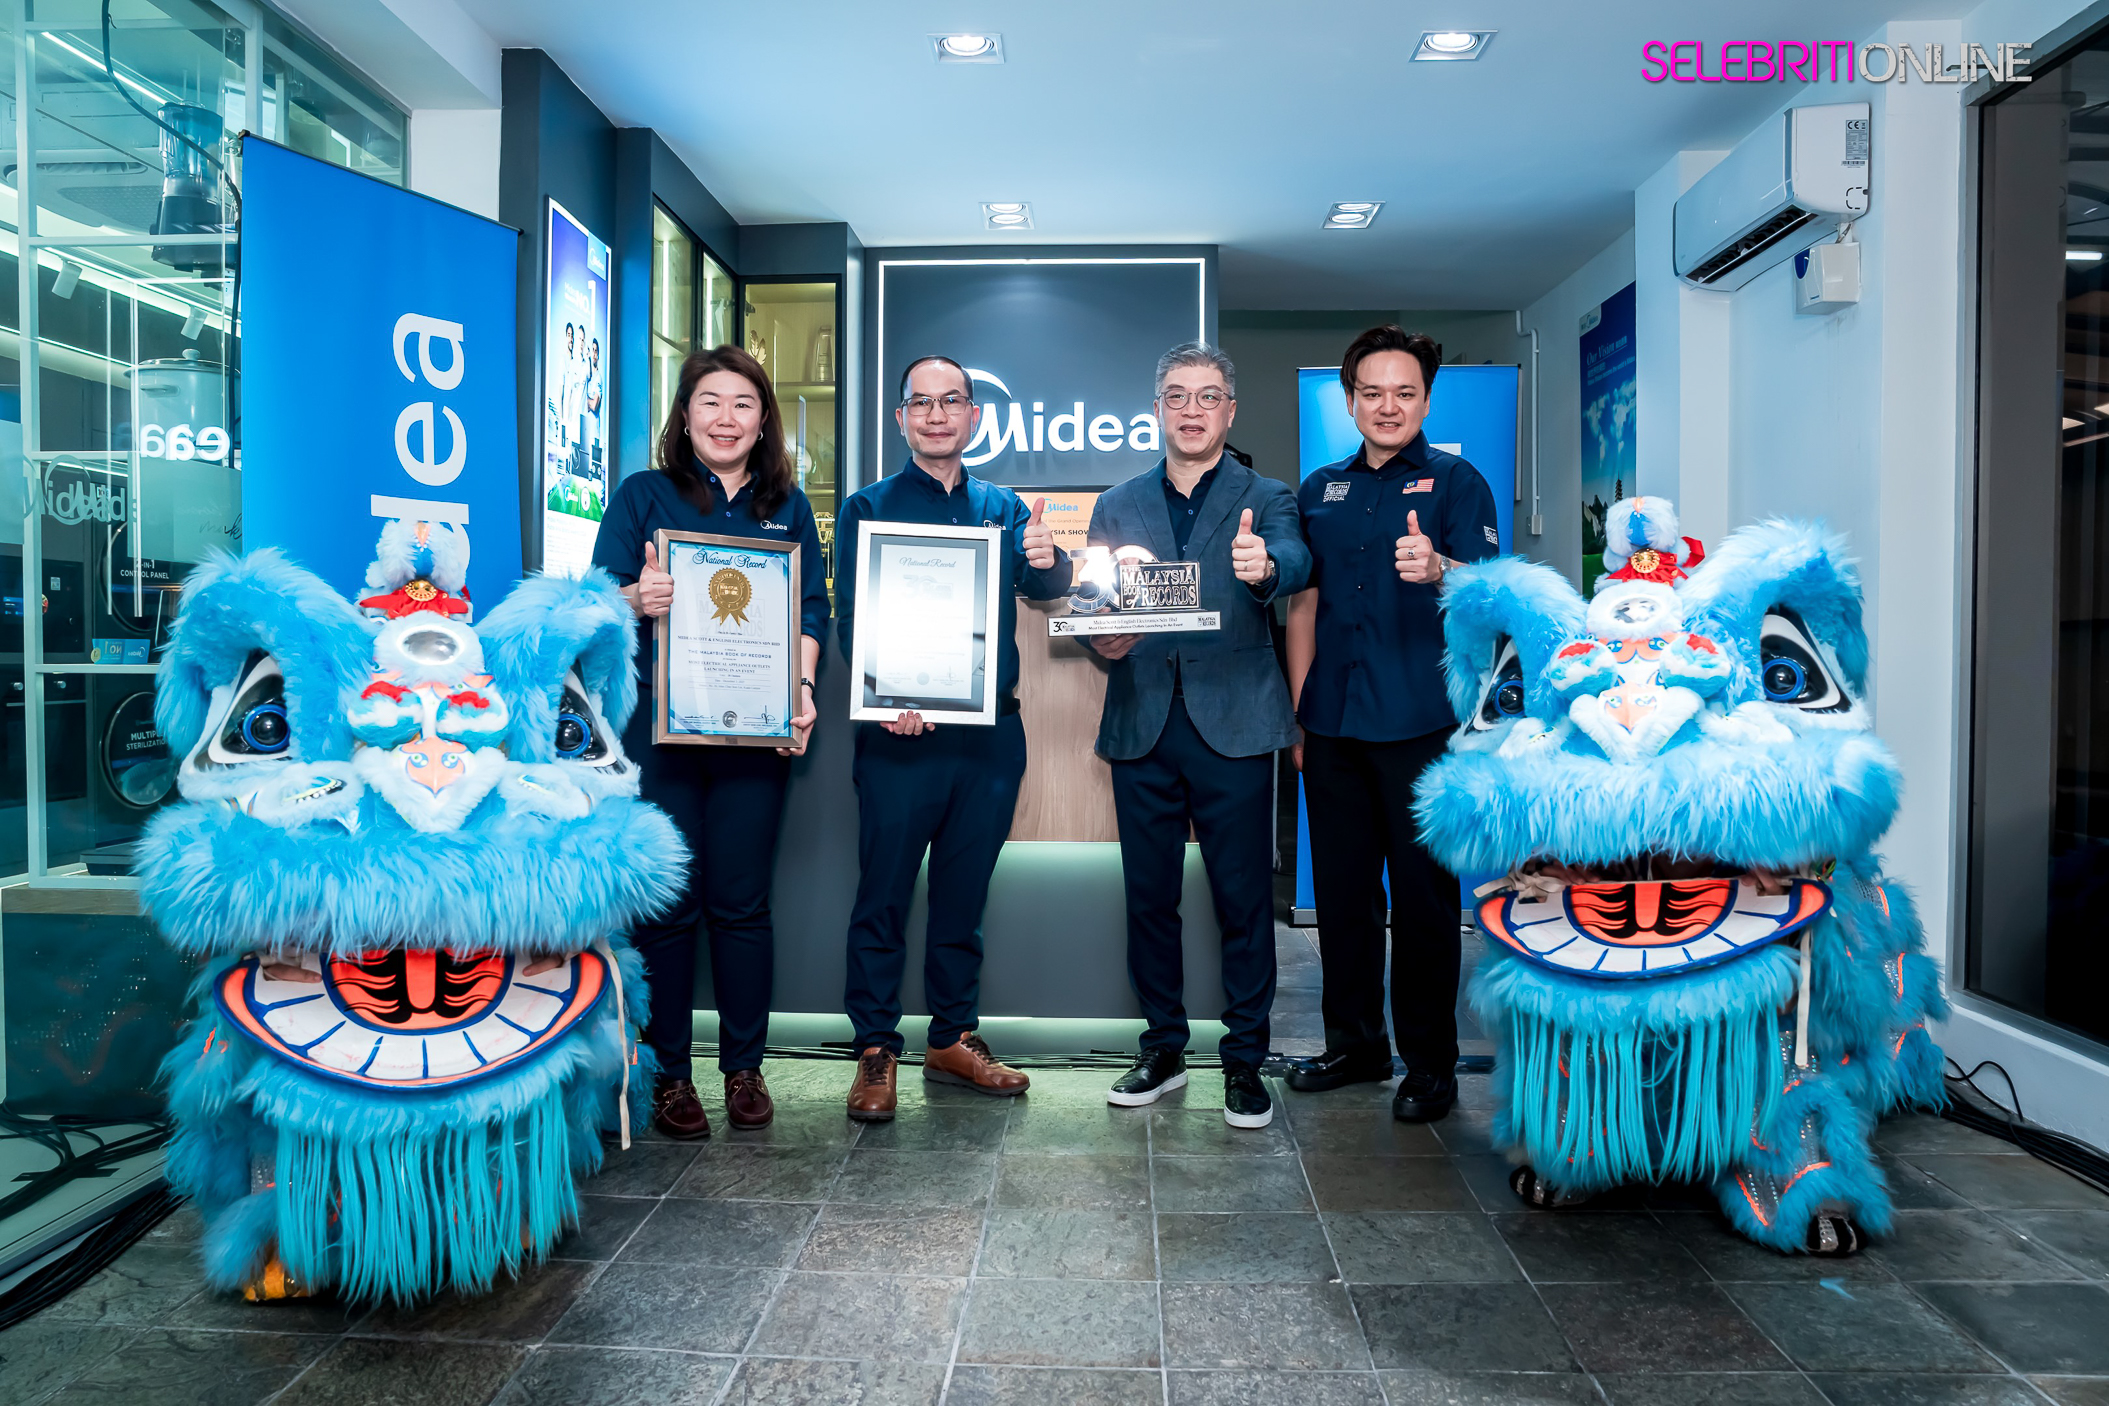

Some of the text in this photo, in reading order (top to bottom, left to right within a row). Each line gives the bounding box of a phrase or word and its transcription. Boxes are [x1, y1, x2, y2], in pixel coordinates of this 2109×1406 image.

[962, 368, 1160, 467] Midea
[371, 313, 473, 622] dea
[1044, 498, 1079, 513] Midea
[760, 520, 788, 531] Midea
[692, 550, 768, 569] National Record
[899, 557, 957, 569] National Record
[120, 569, 169, 580] CONTOL PANEL
[1123, 566, 1196, 586] MALAYSIA
[1141, 586, 1196, 606] RECORDS
